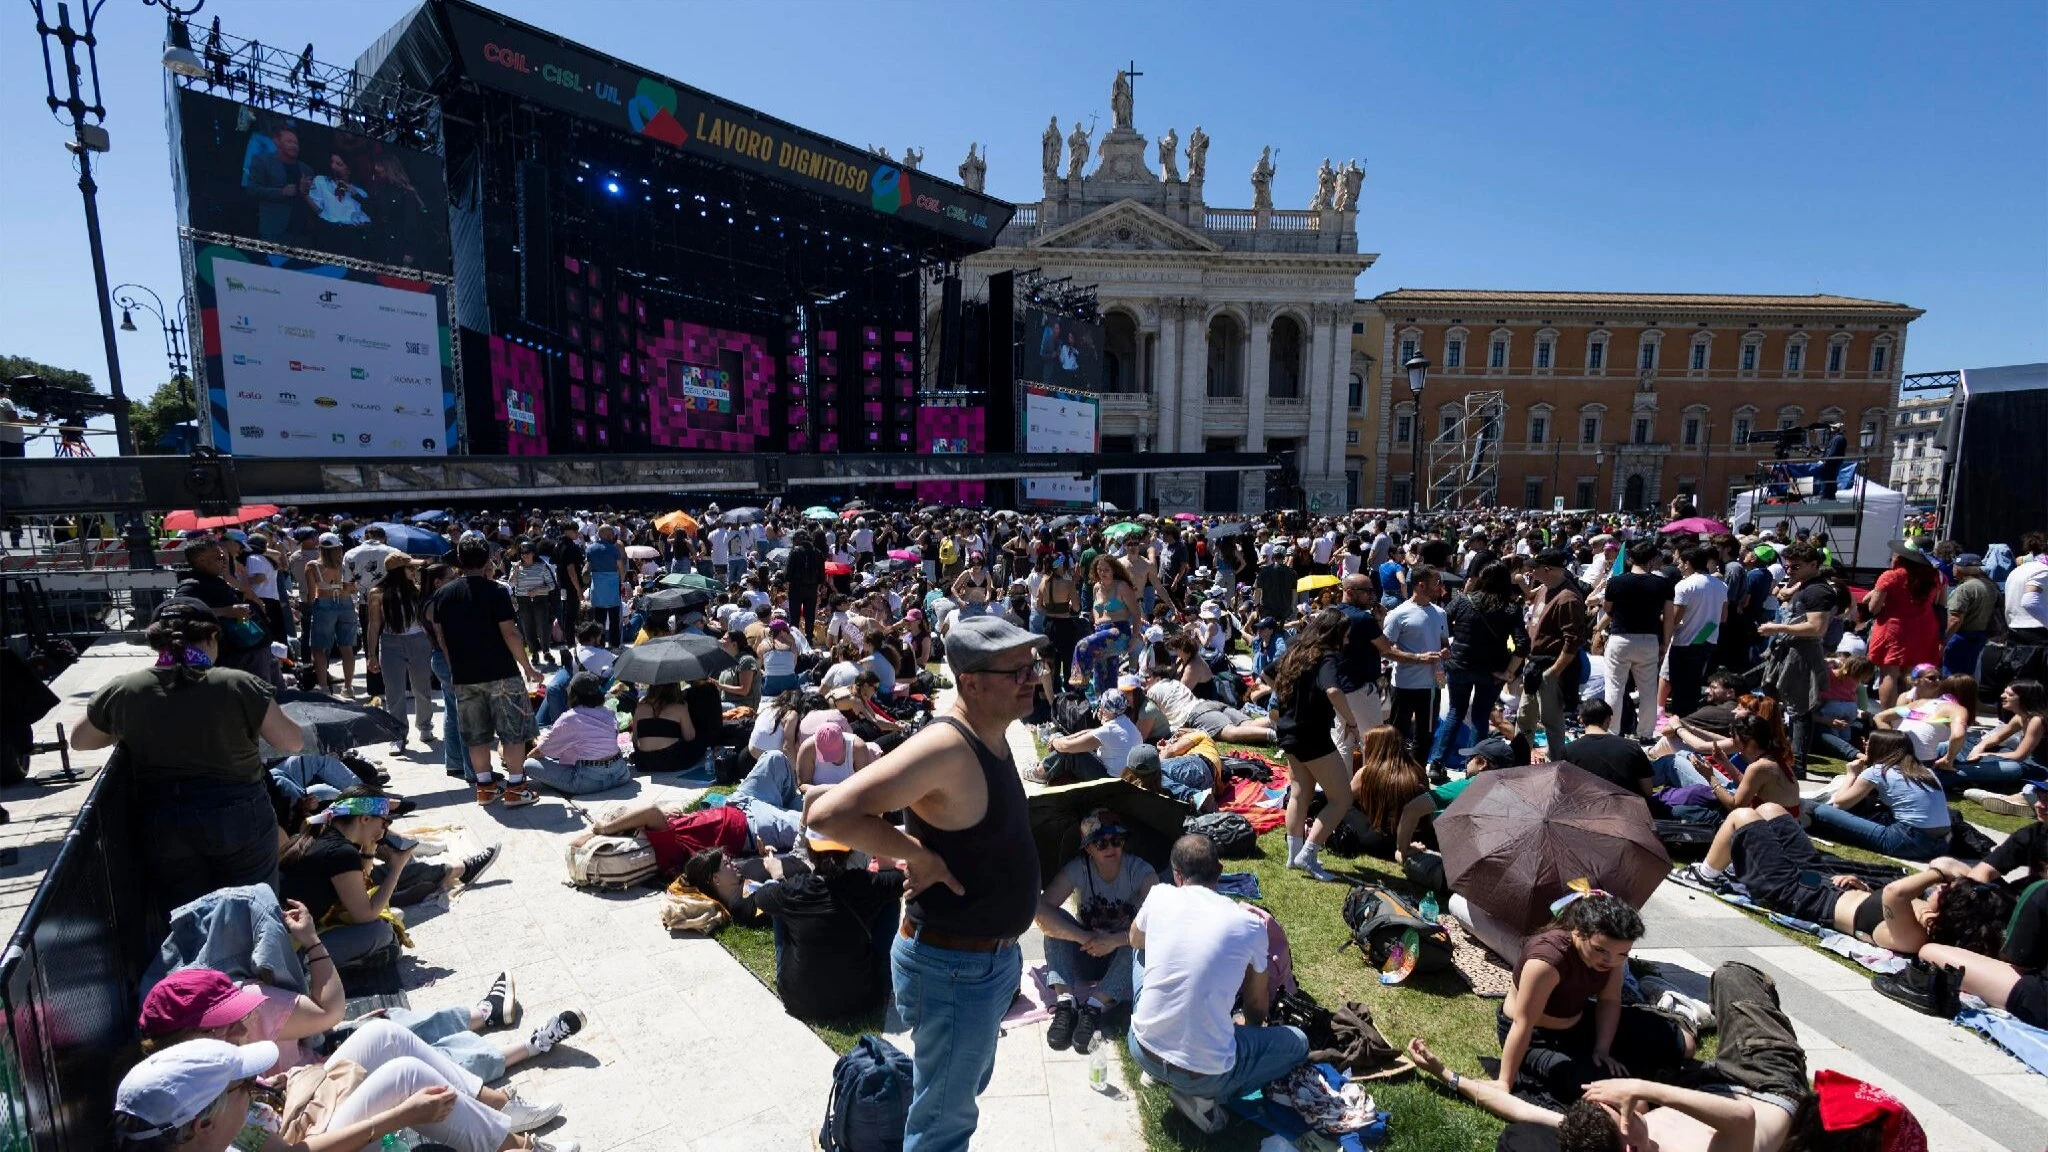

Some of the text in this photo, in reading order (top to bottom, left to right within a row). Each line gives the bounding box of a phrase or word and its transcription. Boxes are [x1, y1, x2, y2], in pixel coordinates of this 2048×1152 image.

[483, 43, 622, 106] CGIL CISL UIL
[696, 112, 868, 193] LAVORO DIGNITOSO
